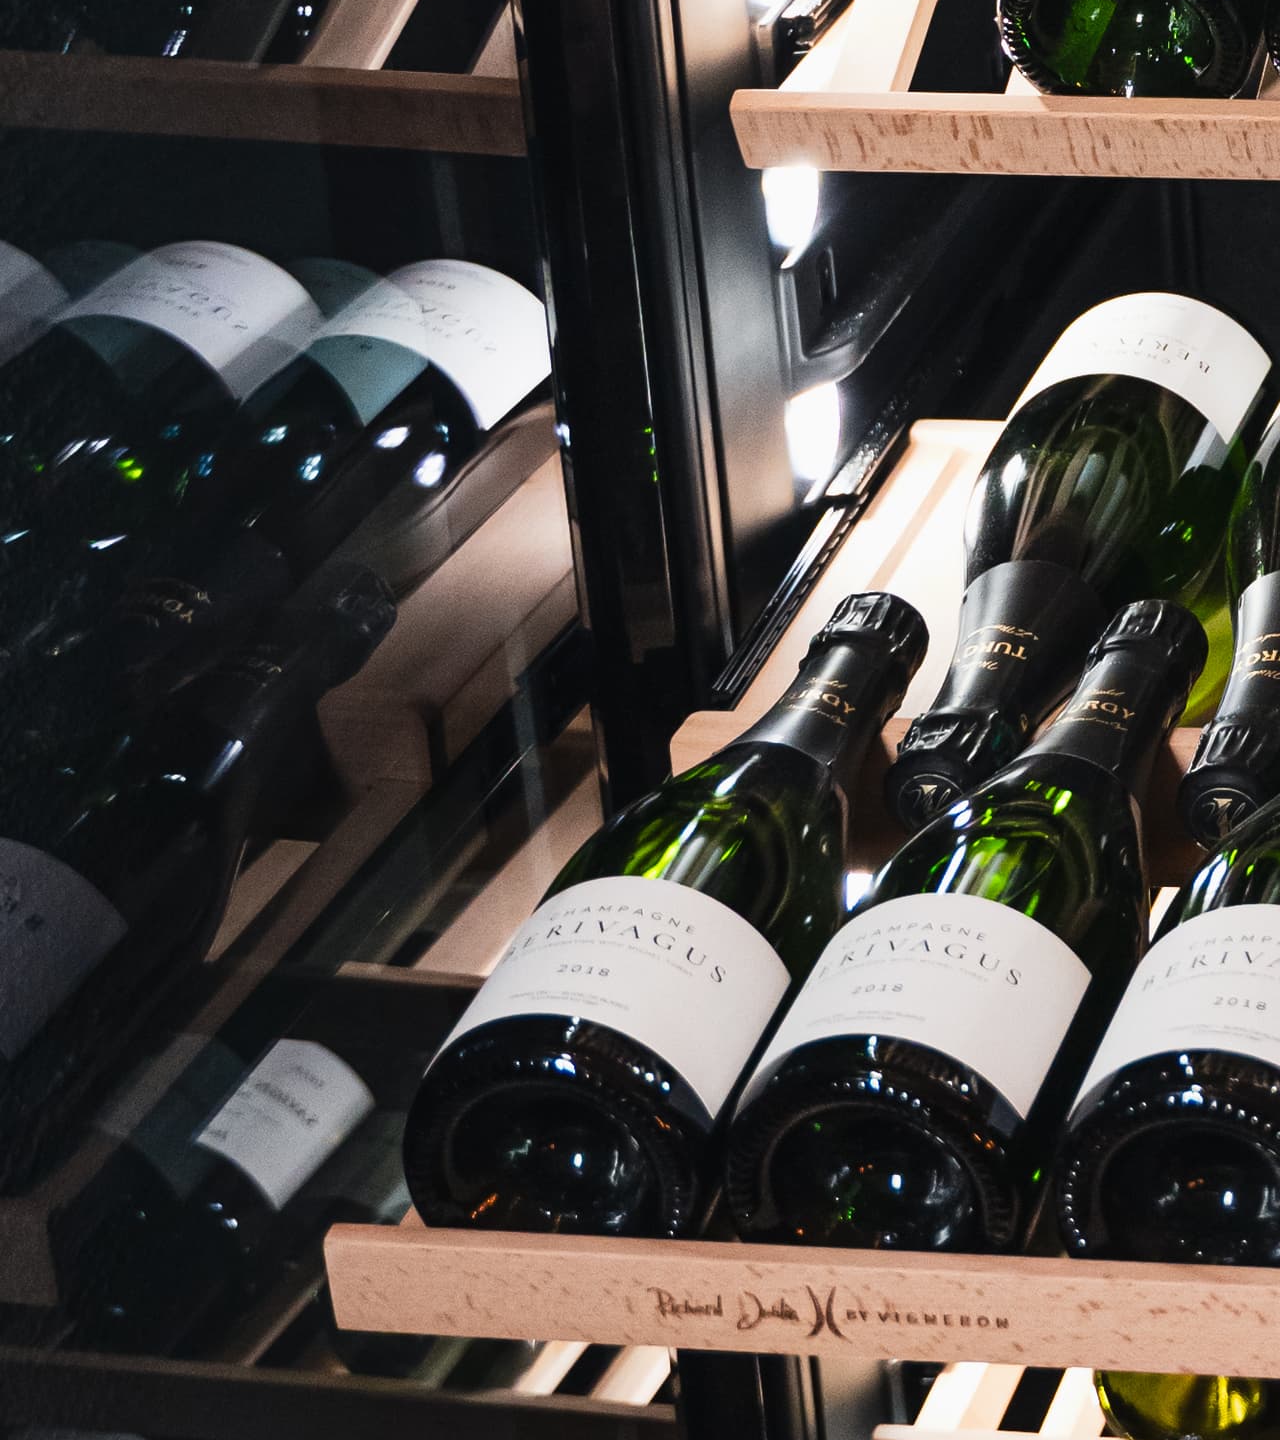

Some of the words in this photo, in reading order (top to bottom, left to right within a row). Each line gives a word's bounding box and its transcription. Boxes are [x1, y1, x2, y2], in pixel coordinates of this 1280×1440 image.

[556, 963, 611, 978] 2018
[816, 939, 1023, 986] ERIVAGUS
[850, 983, 905, 996] 2018
[1212, 995, 1268, 1012] 2018
[845, 1309, 868, 1322] BY
[876, 1310, 1011, 1331] VIGNERON
